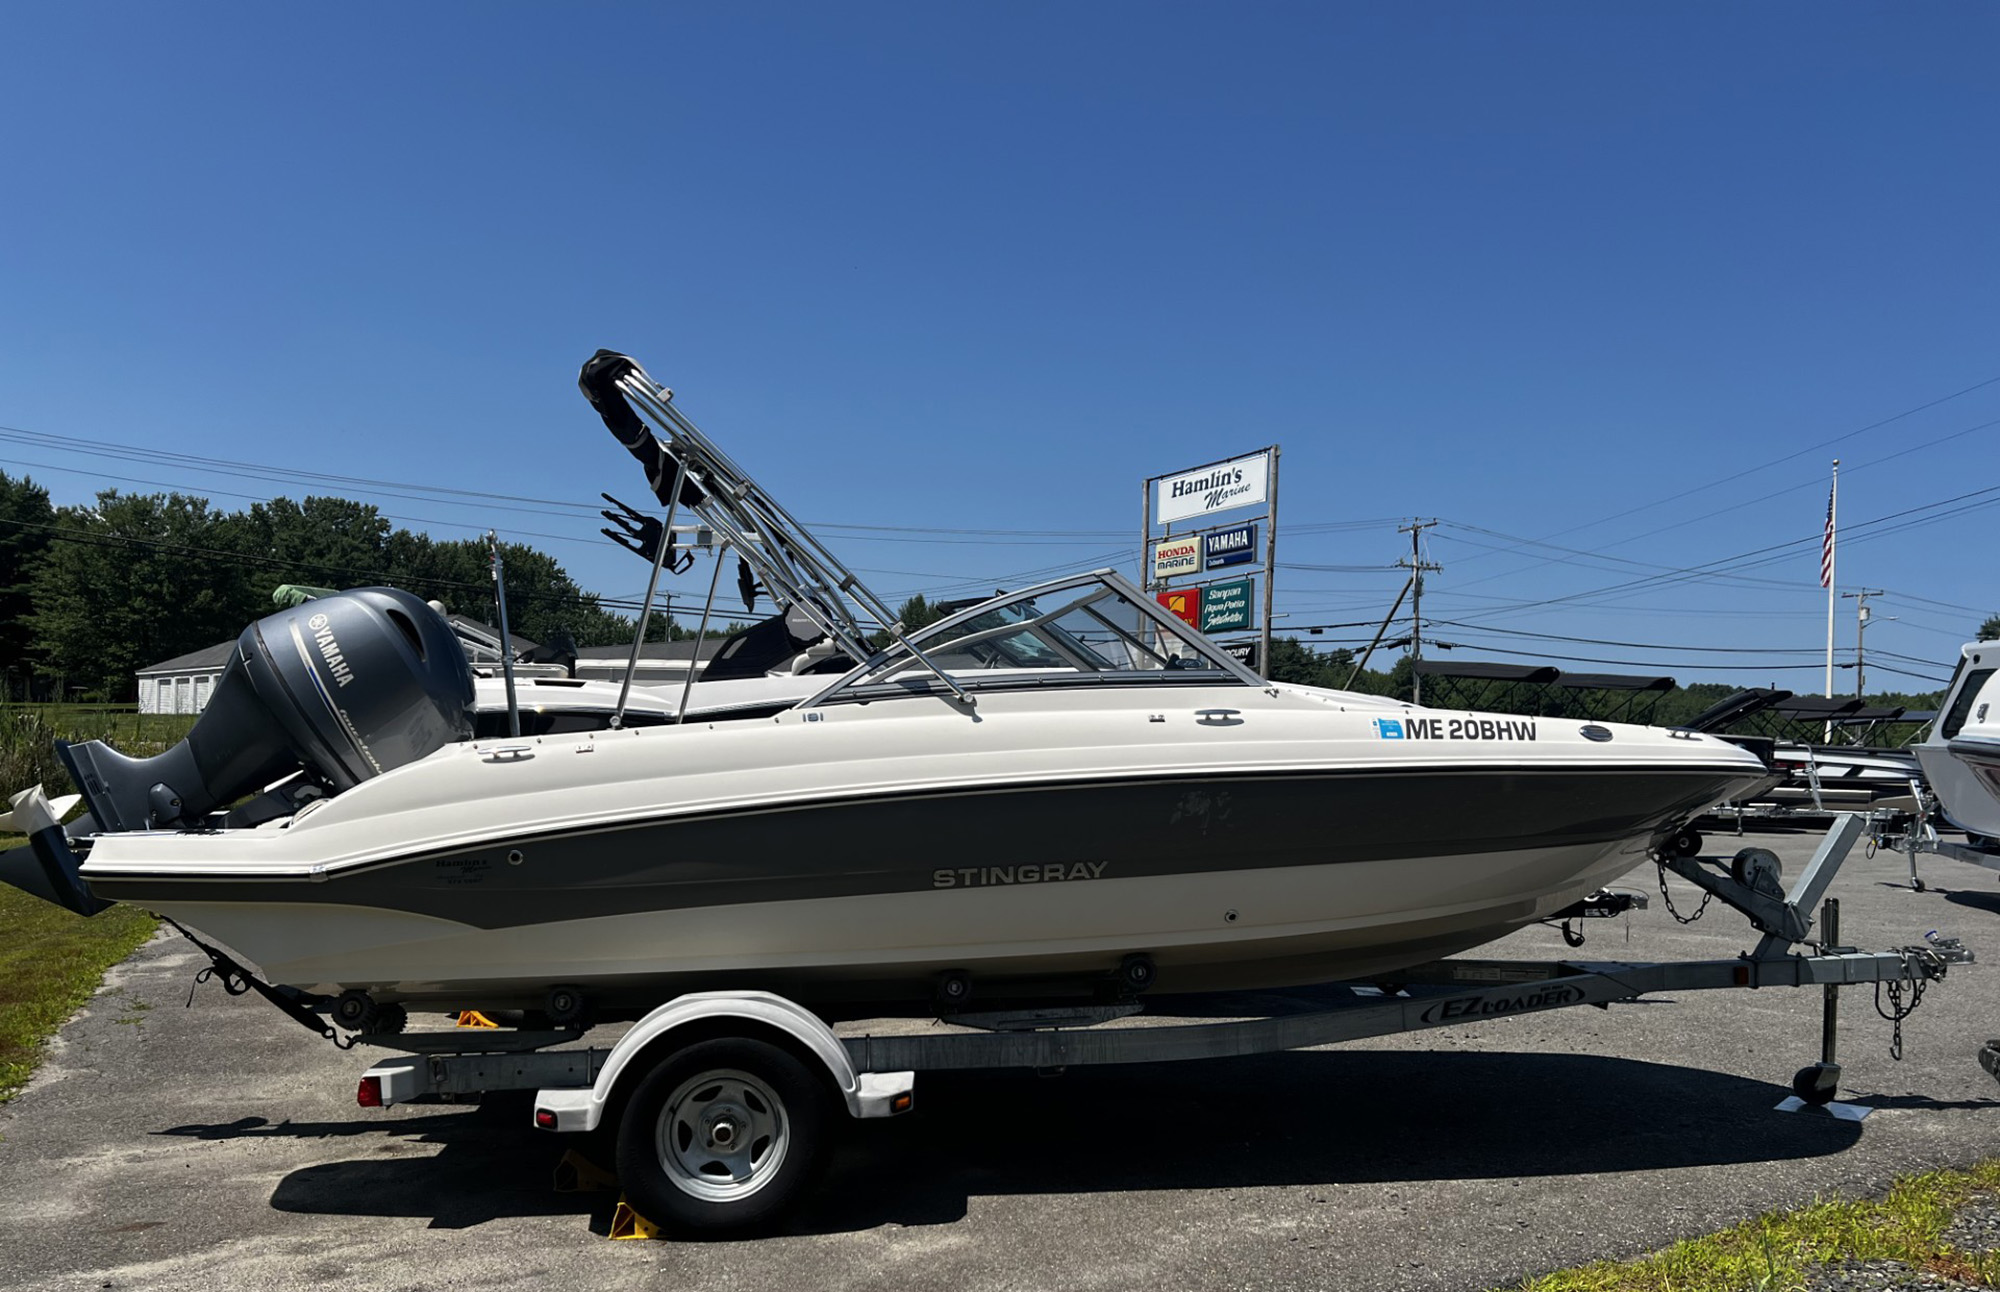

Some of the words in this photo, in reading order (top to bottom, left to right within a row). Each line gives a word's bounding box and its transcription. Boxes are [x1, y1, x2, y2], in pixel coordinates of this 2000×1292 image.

[1171, 467, 1243, 498] Hamlin's
[1204, 483, 1251, 510] Marine
[1157, 545, 1196, 560] HONDA
[1208, 530, 1249, 552] YAMAHA
[314, 625, 354, 688] YAMAHA
[1405, 718, 1444, 740] ME
[1448, 719, 1536, 741] 20BHW
[933, 860, 1109, 888] STINGRAY
